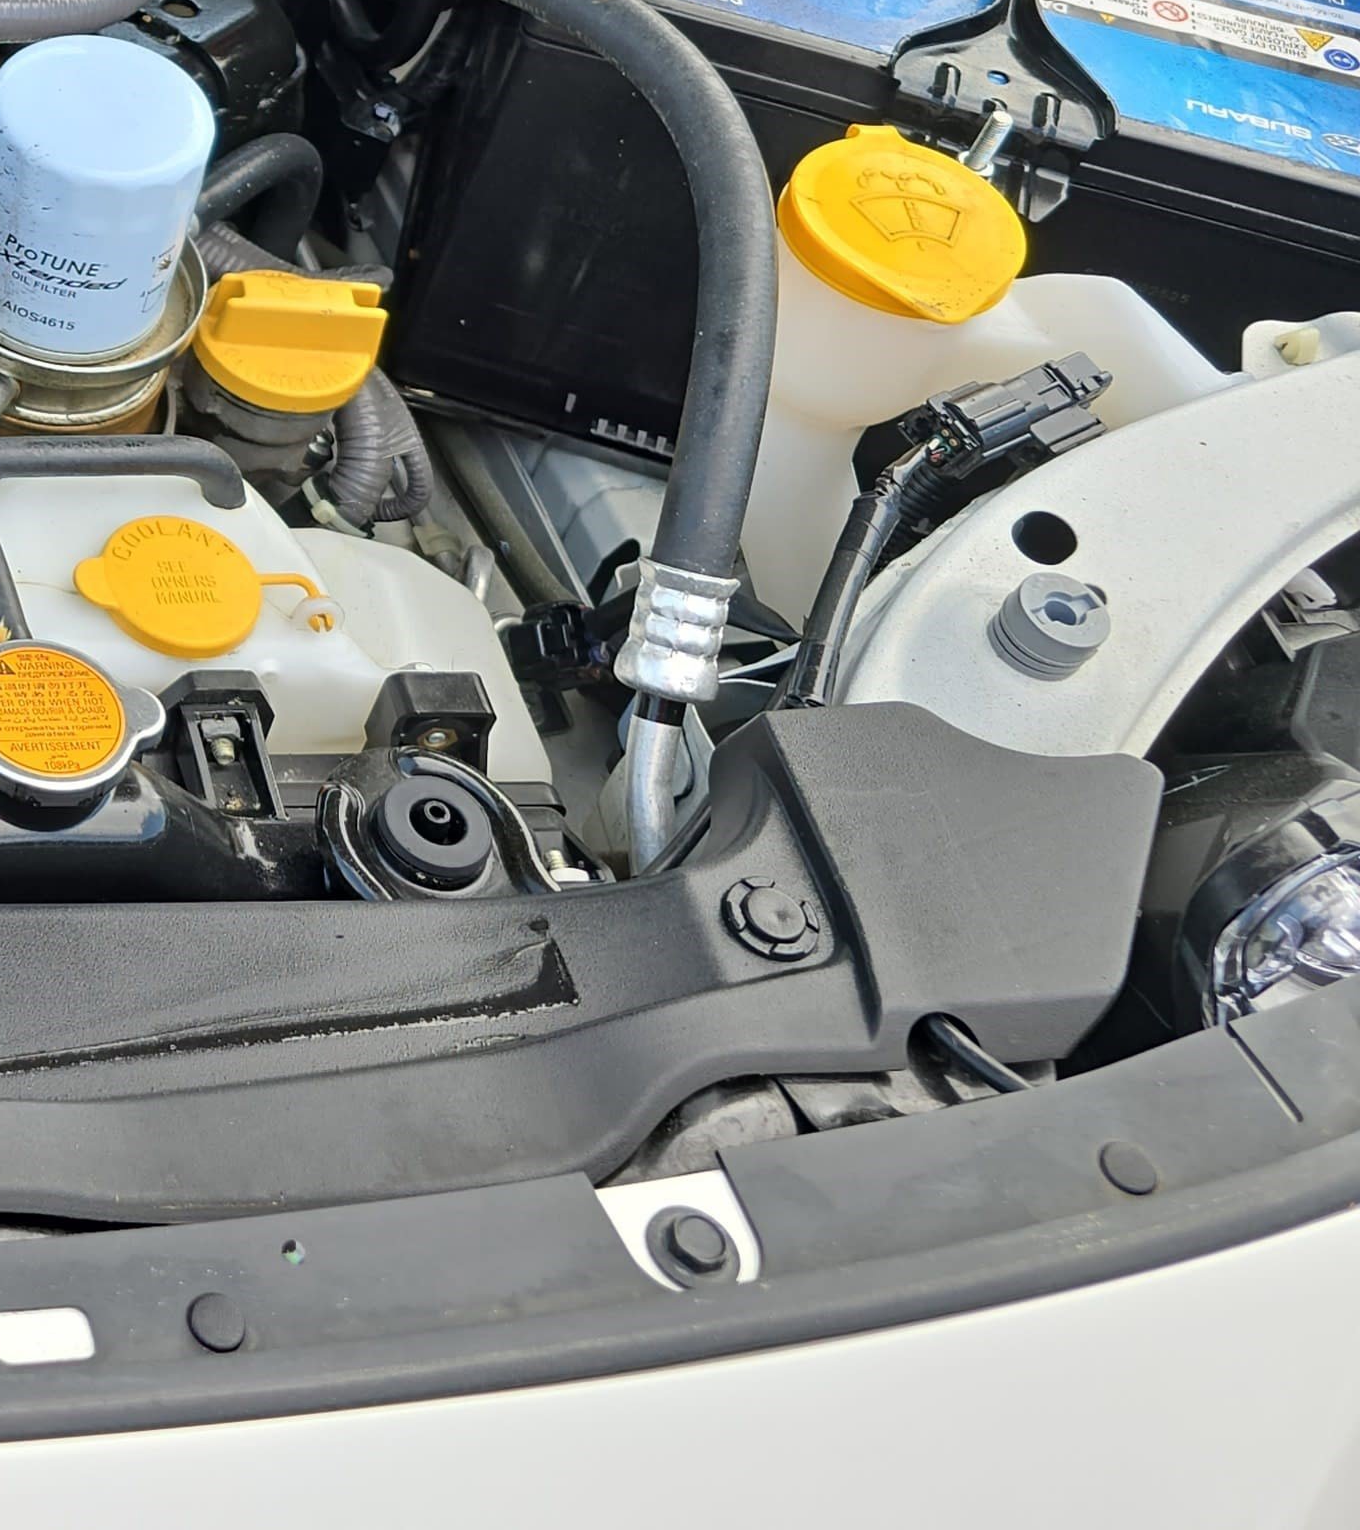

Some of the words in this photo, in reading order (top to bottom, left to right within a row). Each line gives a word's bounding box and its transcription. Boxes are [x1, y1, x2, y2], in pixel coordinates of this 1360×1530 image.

[1185, 98, 1313, 140] SUBARU
[4, 233, 101, 278] ProTUNE
[11, 270, 30, 286] OIL
[32, 281, 77, 299] FILTER
[112, 520, 235, 561] COOLANT
[157, 560, 189, 574] SEE
[155, 589, 223, 605] MANUAL
[16, 661, 74, 671] WARNING
[10, 741, 101, 752] AVERTISSEMENT
